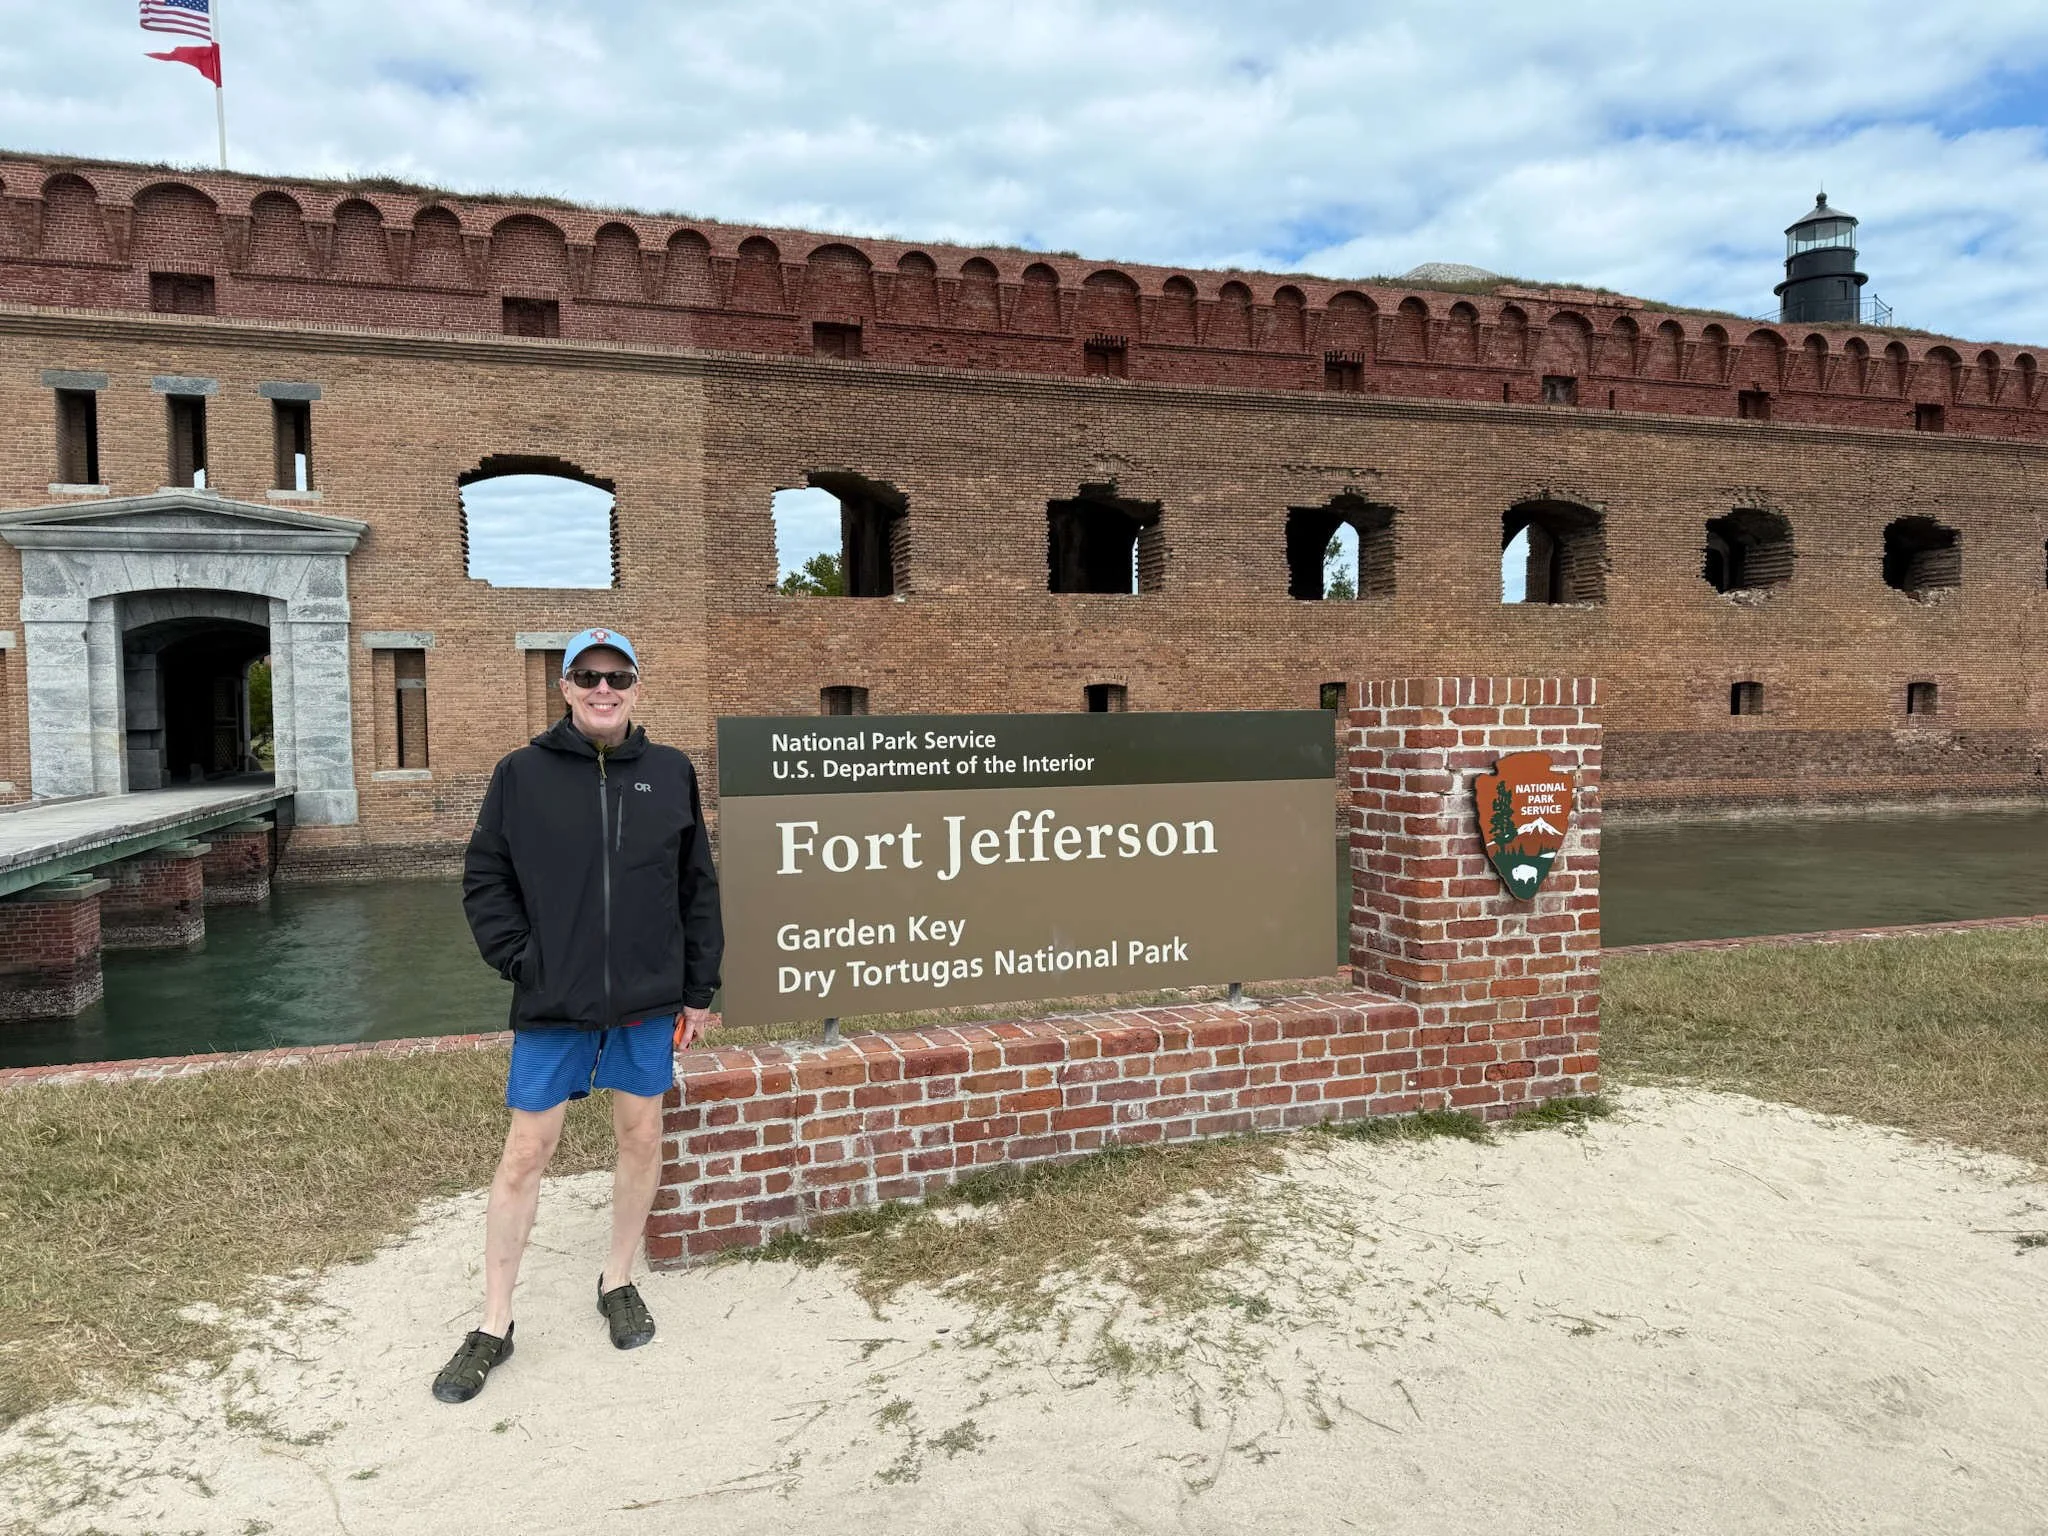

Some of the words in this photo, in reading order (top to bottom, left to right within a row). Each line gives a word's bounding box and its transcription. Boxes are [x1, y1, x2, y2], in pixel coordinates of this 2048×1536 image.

[772, 731, 866, 752] National
[872, 730, 918, 751] Park
[924, 729, 997, 751] Service
[772, 760, 815, 779] U.S.
[823, 758, 951, 782] Department
[956, 755, 978, 775] of
[983, 755, 1017, 774] the
[1023, 752, 1095, 773] Interior
[634, 782, 652, 792] OR
[1515, 783, 1567, 793] NATIONAL
[1520, 805, 1562, 816] SERVICE
[1527, 794, 1555, 804] PARK
[775, 820, 923, 875] Fort
[936, 810, 1219, 881] Jefferson
[776, 918, 896, 951] Garden
[908, 914, 967, 947] Key
[778, 964, 836, 998] Dry
[846, 957, 984, 988] Tortugas
[994, 940, 1118, 976] National
[1128, 935, 1189, 967] Park
